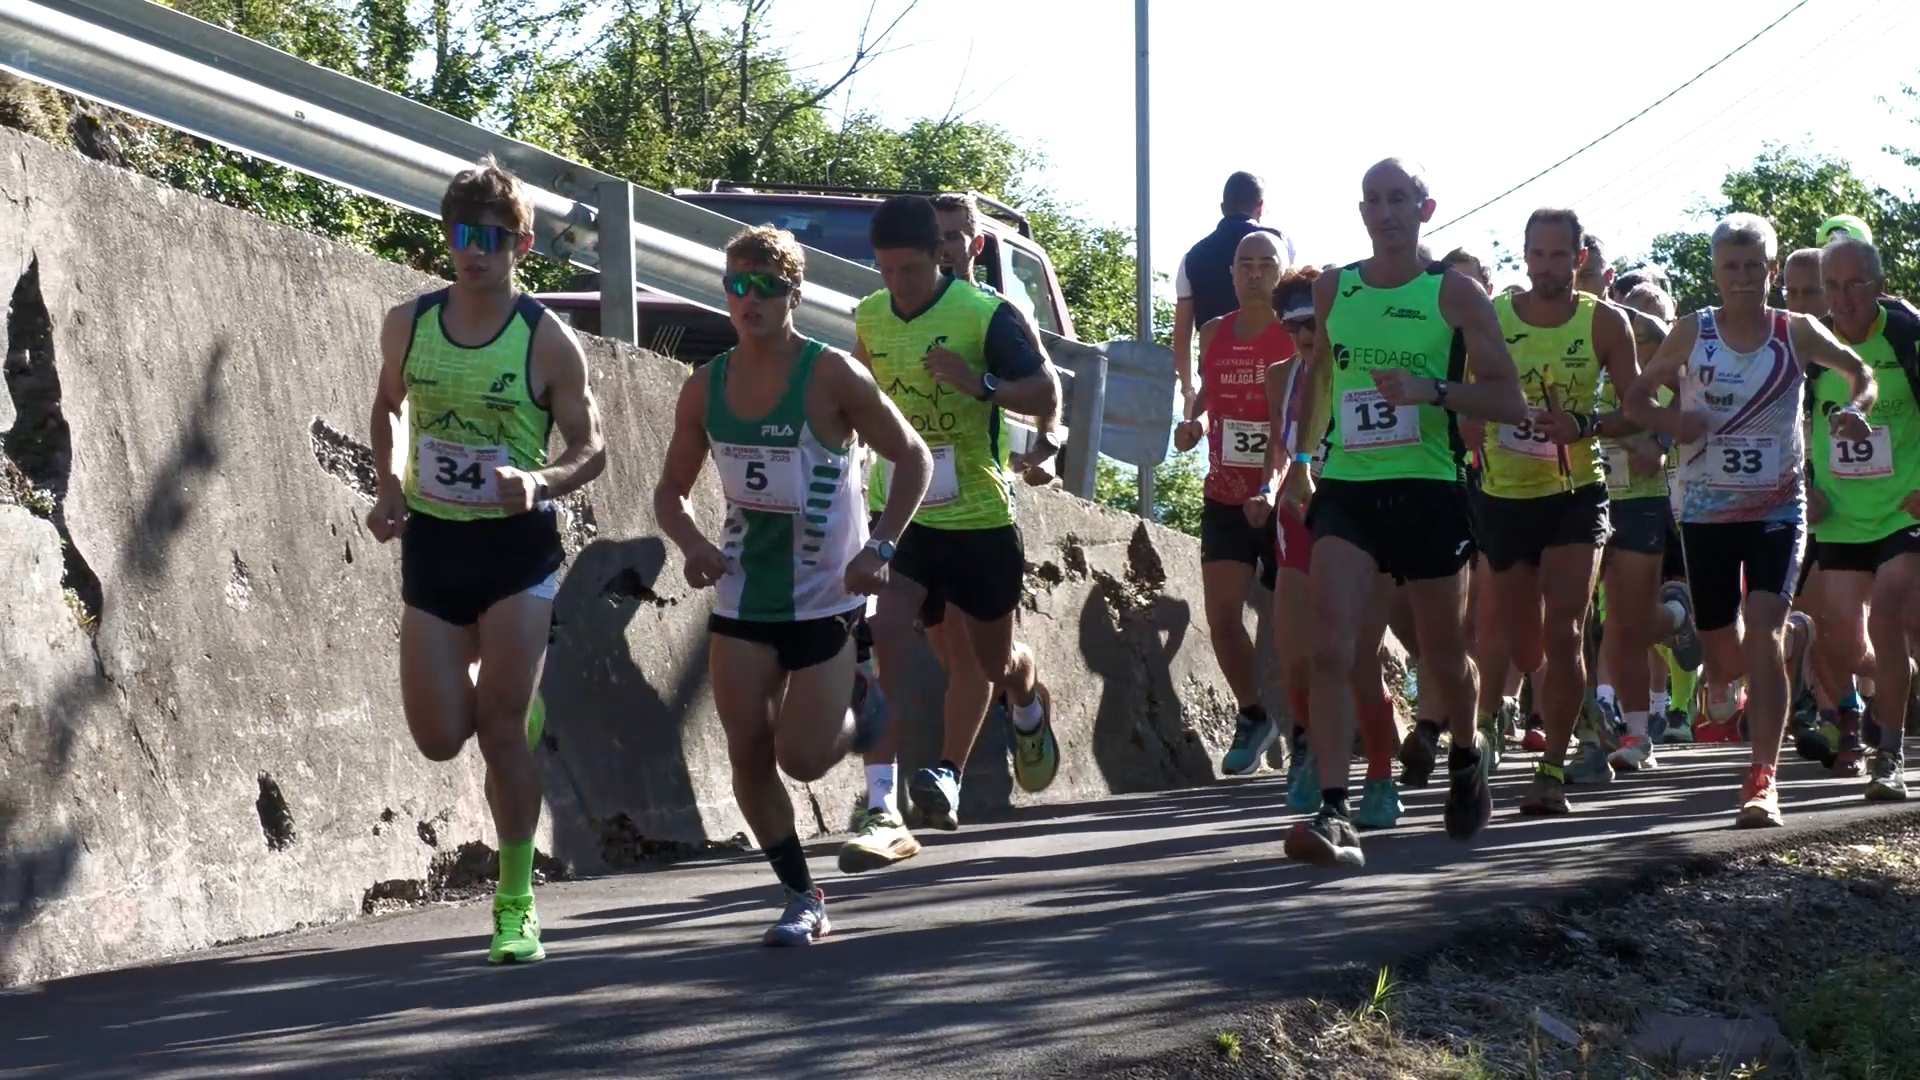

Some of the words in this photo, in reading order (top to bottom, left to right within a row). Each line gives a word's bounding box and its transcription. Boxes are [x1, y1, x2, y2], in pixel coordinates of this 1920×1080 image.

[1353, 347, 1427, 369] FEDABO
[911, 412, 956, 431] OLO
[1355, 401, 1398, 431] 13
[761, 425, 794, 437] FILA
[1234, 432, 1268, 453] 32
[1722, 449, 1763, 474] 33
[1836, 440, 1873, 463] 19
[435, 456, 486, 490] 34
[745, 461, 768, 491] 5
